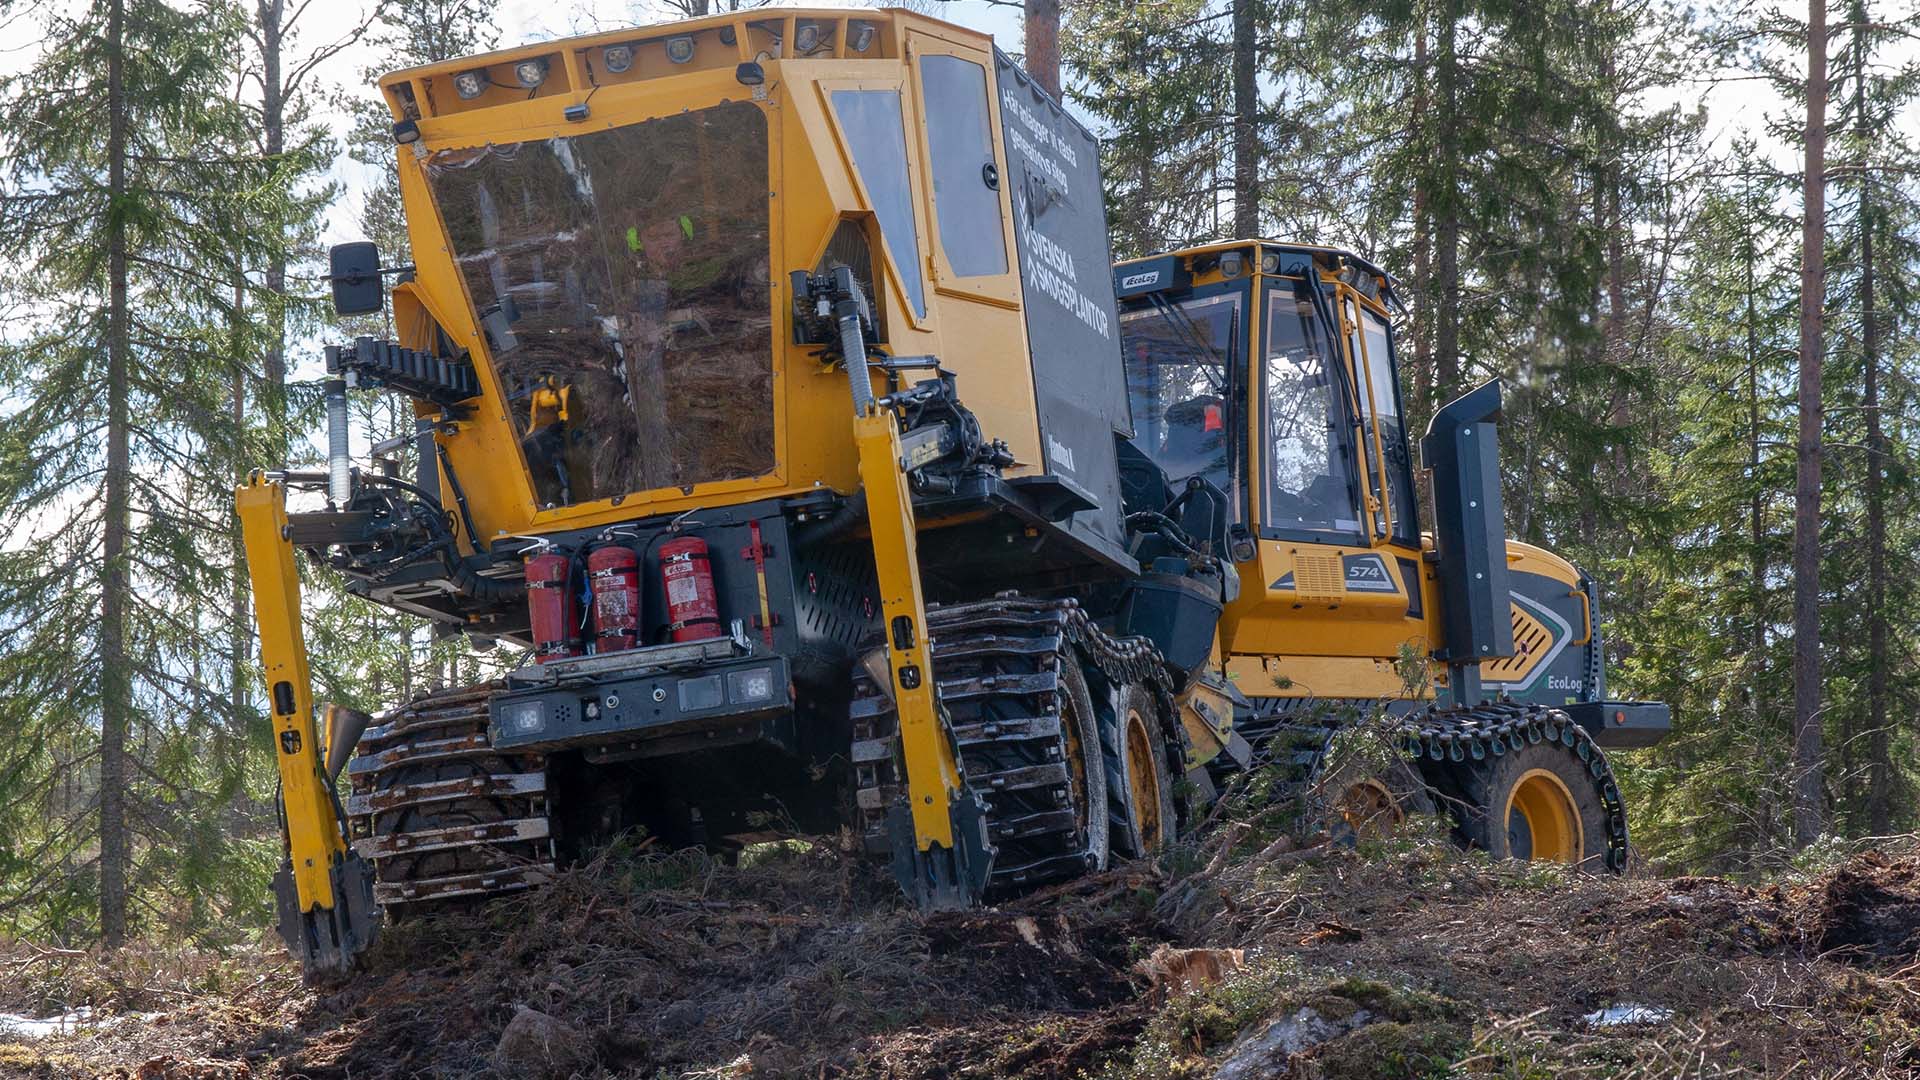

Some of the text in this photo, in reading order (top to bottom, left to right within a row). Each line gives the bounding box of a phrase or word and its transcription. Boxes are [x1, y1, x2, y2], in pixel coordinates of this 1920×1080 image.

[1030, 227, 1077, 283] SVENSKA
[1036, 263, 1109, 339] SKOGSPLANTOR
[1349, 566, 1379, 577] 574
[1548, 675, 1582, 693] EcoLog
